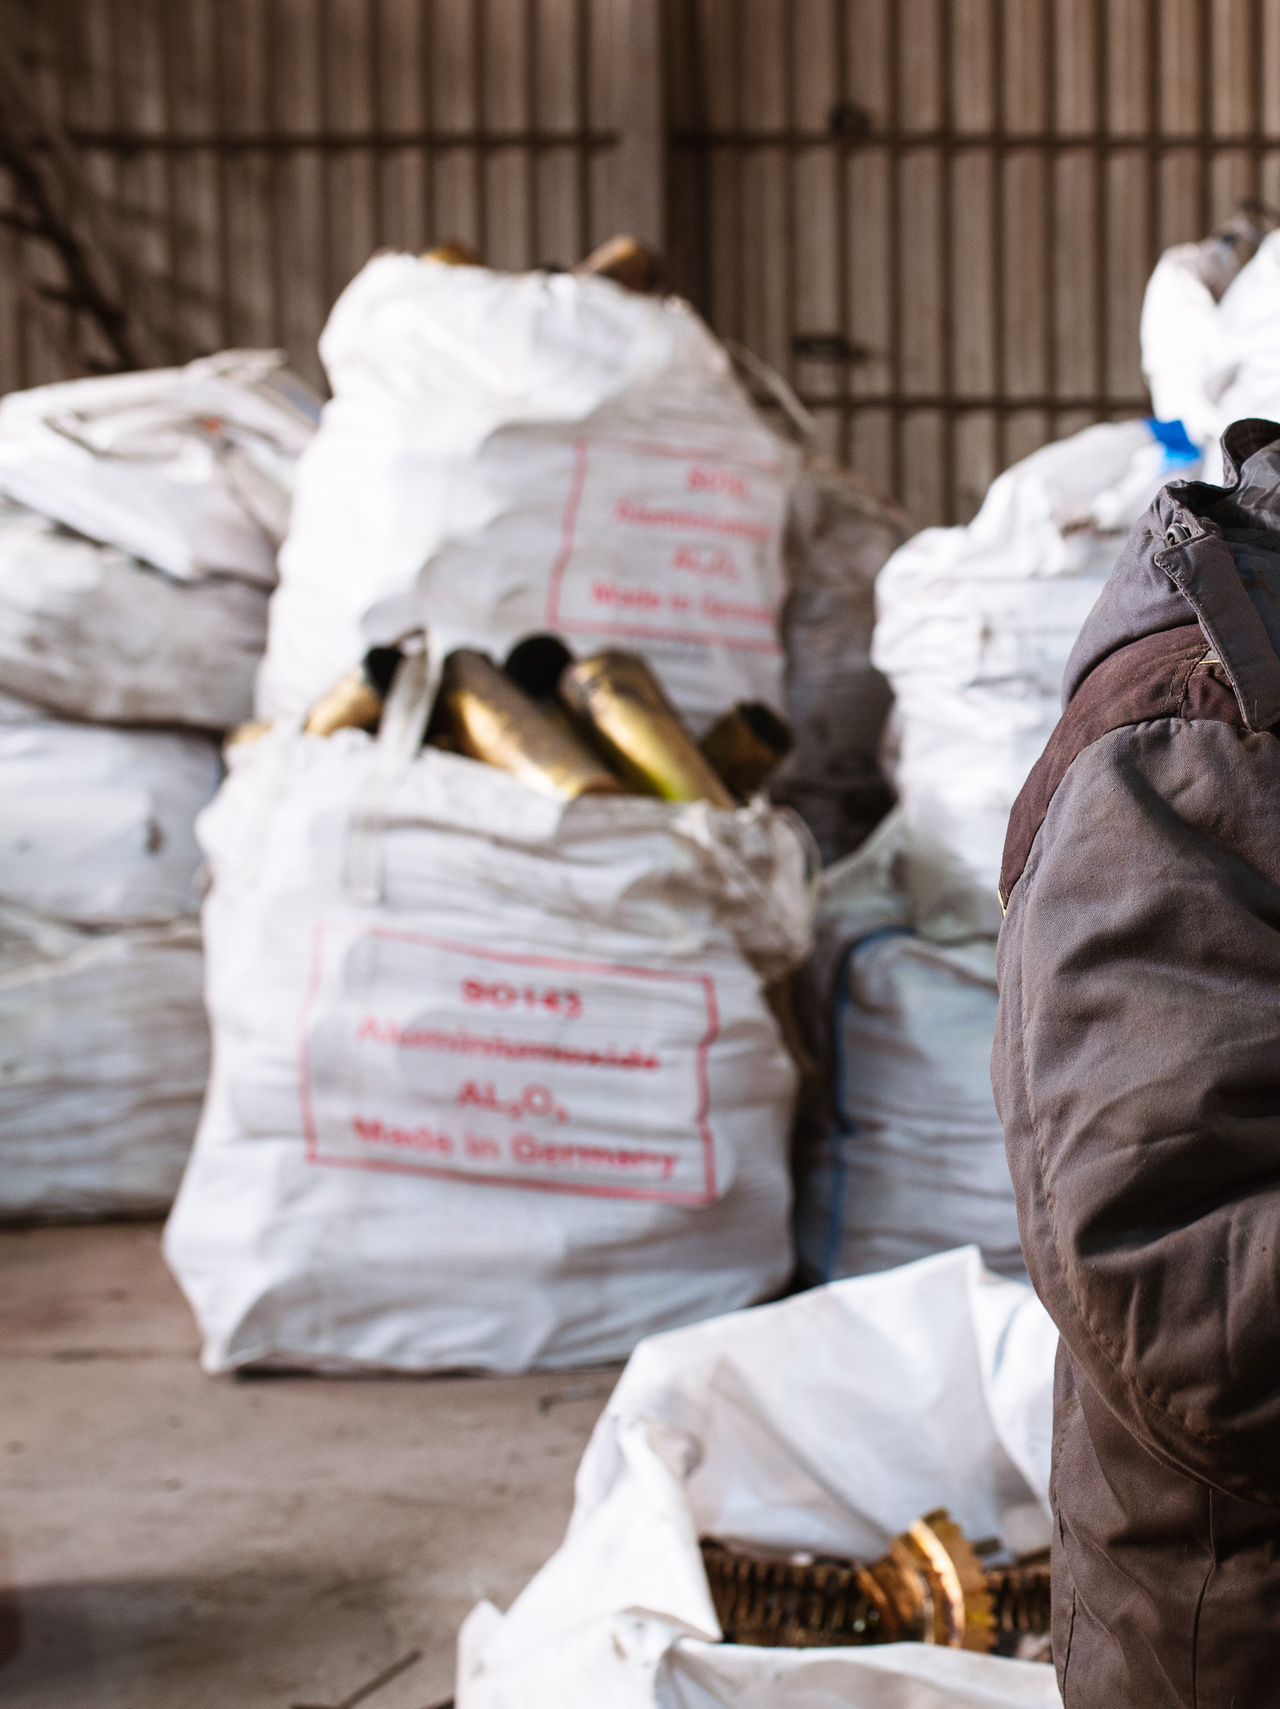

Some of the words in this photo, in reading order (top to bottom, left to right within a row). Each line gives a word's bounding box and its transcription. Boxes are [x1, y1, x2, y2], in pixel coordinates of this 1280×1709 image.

[352, 1113, 455, 1157] Made
[464, 1131, 501, 1160] in
[509, 1133, 681, 1181] Germany
